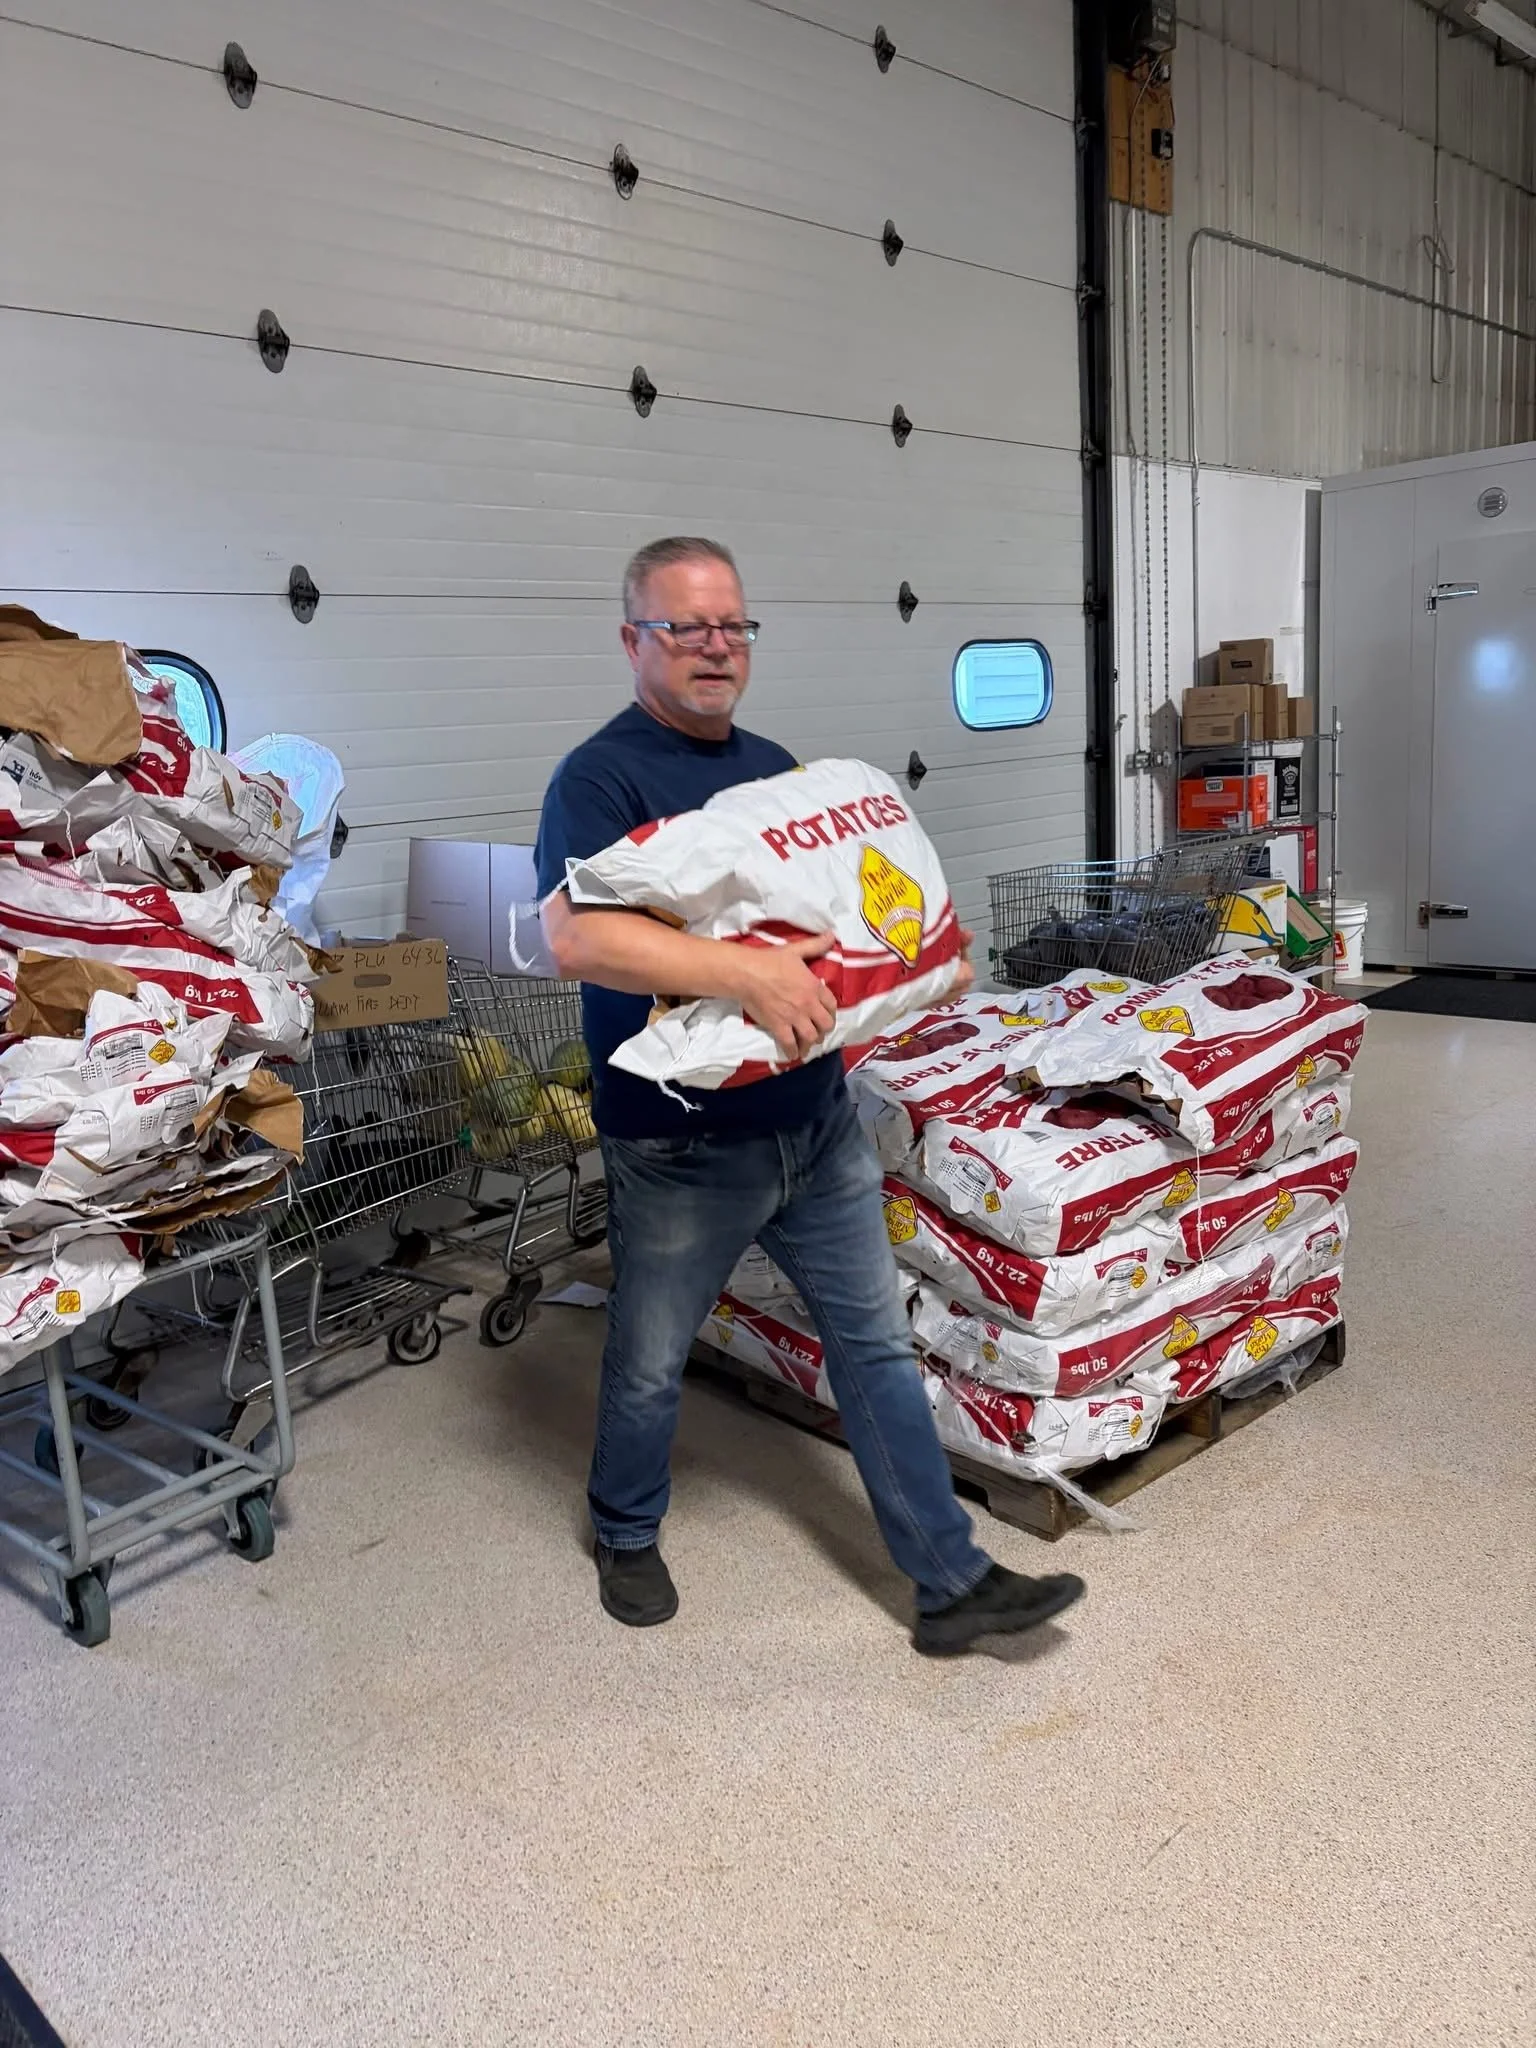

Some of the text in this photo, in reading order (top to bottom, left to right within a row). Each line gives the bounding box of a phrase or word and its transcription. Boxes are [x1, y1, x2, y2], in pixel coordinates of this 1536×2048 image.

[760, 794, 908, 862] POTATOES
[354, 952, 385, 969] PLU
[184, 984, 204, 1000] kg
[881, 1060, 963, 1091] TERRE
[940, 1100, 955, 1110] 50
[1222, 1105, 1240, 1119] lbs
[1056, 1132, 1146, 1171] TERRE
[1074, 1203, 1110, 1225] 50 lbs
[1212, 1216, 1227, 1231] 50
[976, 1248, 1029, 1285] 22.7 kg
[778, 1336, 815, 1365] 22.7 kg
[1071, 1356, 1108, 1376] 50 lbs
[975, 1386, 1017, 1419] 22.7 kg
